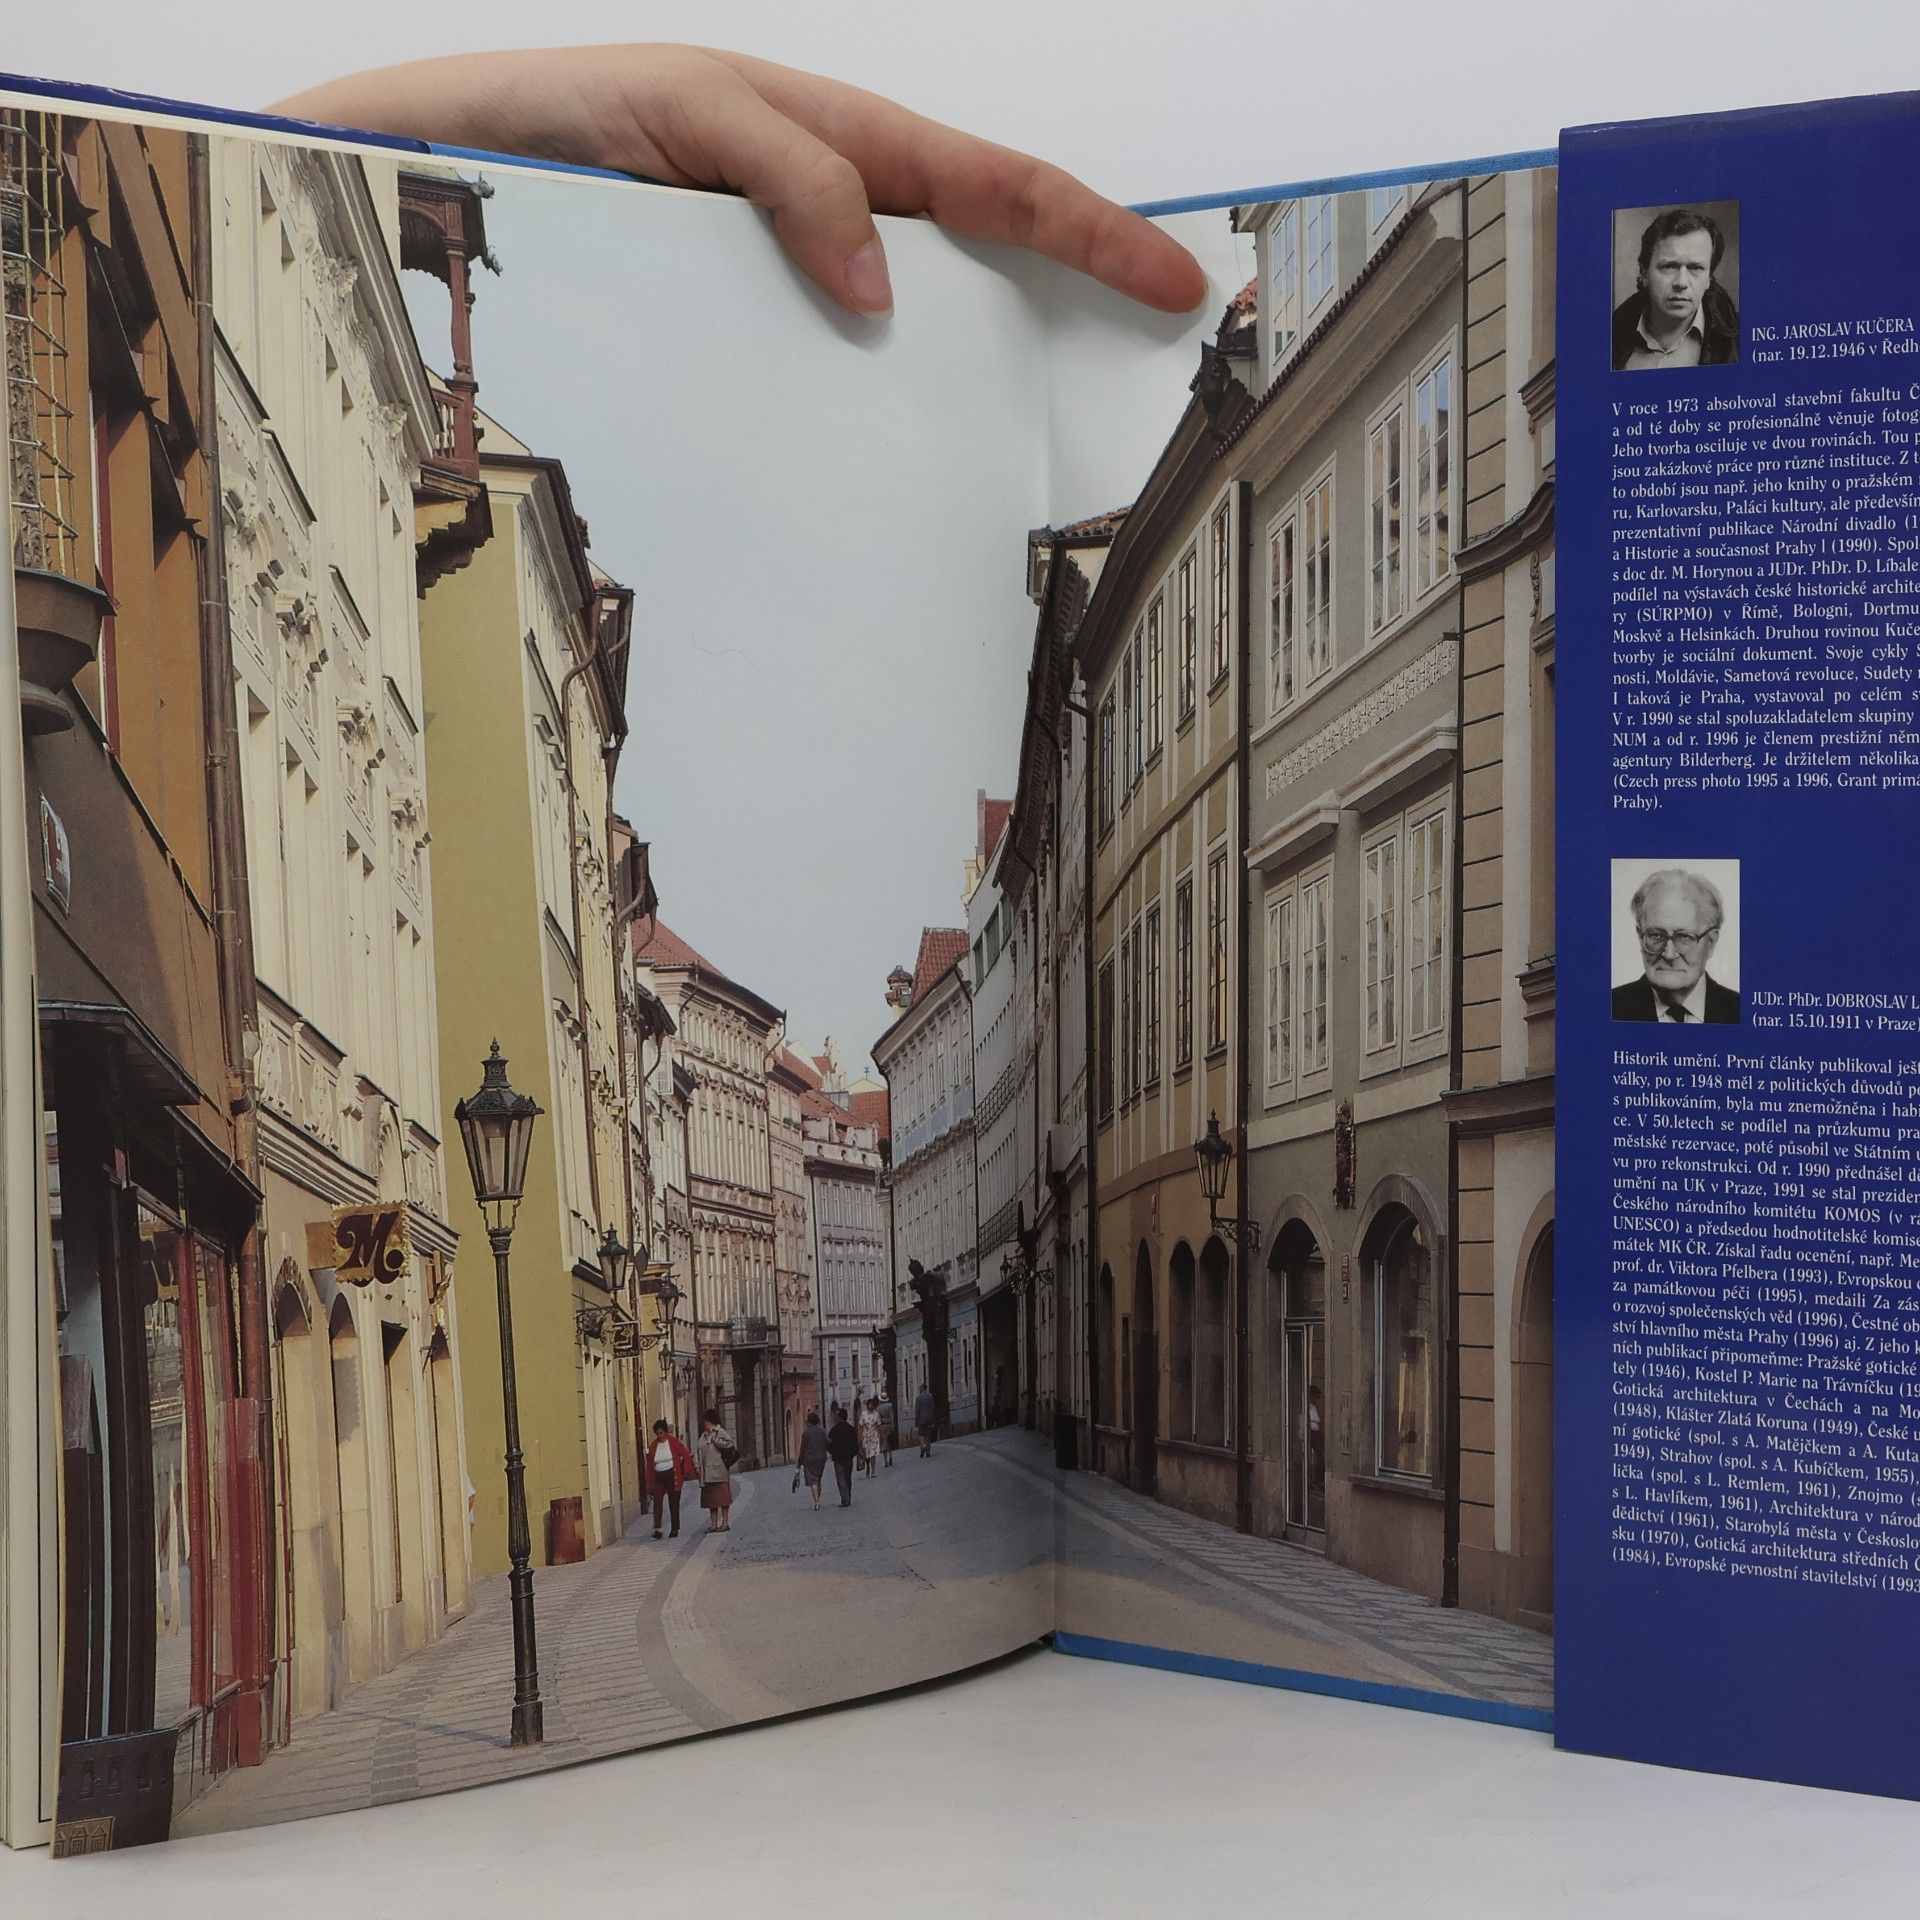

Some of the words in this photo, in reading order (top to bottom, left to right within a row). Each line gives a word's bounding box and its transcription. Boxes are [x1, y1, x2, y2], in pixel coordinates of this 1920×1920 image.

[1752, 326, 1780, 342] ING.
[1783, 321, 1852, 340] JAROSLAV
[1856, 317, 1914, 335] KUČERA
[1752, 349, 1784, 363] (nar.
[1790, 341, 1865, 360] 19.12.1946
[1869, 345, 1877, 355] v
[1882, 337, 1920, 355] Ředh
[1612, 402, 1622, 416] V
[1630, 404, 1658, 415] roce
[1667, 398, 1699, 413] 1973
[1706, 393, 1776, 411] absolvoval
[1784, 389, 1843, 407] stavební
[1850, 386, 1901, 403] fakultu
[1612, 442, 1643, 458] Jeho
[1648, 440, 1690, 456] tvorba
[1695, 437, 1747, 454] osciluje
[1751, 440, 1767, 450] ve
[1772, 435, 1805, 450] dvou
[1811, 430, 1876, 448] rovinách.
[1881, 429, 1909, 444] Tou
[1613, 509, 1632, 520] ru,
[1636, 501, 1722, 518] Karlovarsku,
[1726, 499, 1767, 515] Paláci
[1771, 497, 1826, 514] kultury,
[1830, 495, 1850, 511] ale
[1612, 523, 1702, 543] prezentativní
[1709, 520, 1774, 539] publikace
[1782, 517, 1838, 534] Národní
[1845, 515, 1896, 531] divadlo
[1613, 586, 1657, 605] podílel
[1663, 590, 1679, 600] na
[1684, 583, 1749, 603] výstavách
[1755, 582, 1792, 598] české
[1797, 580, 1867, 597] historické
[1613, 612, 1626, 625] ry
[1637, 604, 1713, 623] (SÚRPMO)
[1723, 609, 1731, 619] v
[1742, 602, 1782, 620] Římě,
[1793, 602, 1852, 620] Bologni,
[1613, 628, 1662, 643] Moskvě
[1667, 632, 1674, 642] a
[1680, 625, 1759, 642] Helsinkách.
[1765, 624, 1819, 640] Druhou
[1824, 624, 1879, 638] rovinou
[1613, 670, 1650, 686] nosti,
[1655, 669, 1719, 685] Moldávie,
[1723, 667, 1791, 683] Sametová
[1795, 666, 1858, 682] revoluce,
[1864, 665, 1913, 682] Sudety
[1612, 712, 1623, 726] V
[1627, 716, 1636, 726] r.
[1642, 711, 1673, 726] 1990
[1678, 715, 1692, 725] se
[1697, 710, 1720, 725] stal
[1725, 708, 1853, 727] spoluzakladatelem
[1858, 708, 1914, 725] skupiny
[1613, 753, 1673, 770] agentury
[1680, 752, 1756, 769] Bilderberg.
[1763, 752, 1777, 766] Je
[1785, 751, 1851, 766] držitelem
[1859, 750, 1919, 765] několika
[1613, 794, 1662, 811] Prahy).
[1751, 991, 1784, 1006] JUDr.
[1788, 992, 1822, 1007] PhDr.
[1826, 993, 1908, 1009] DOBROSLAV
[1753, 1012, 1783, 1028] (nar.
[1789, 1013, 1860, 1029] 15.10.1911
[1865, 1019, 1874, 1029] v
[1614, 1050, 1668, 1066] Historik
[1674, 1053, 1721, 1068] umění.
[1727, 1054, 1765, 1069] První
[1769, 1055, 1814, 1074] články
[1820, 1057, 1892, 1074] publikoval
[1613, 1095, 1620, 1105] s
[1625, 1092, 1721, 1111] publikováním,
[1726, 1095, 1754, 1113] byla
[1759, 1101, 1782, 1112] mu
[1882, 1102, 1886, 1116] i
[1613, 1134, 1667, 1149] městské
[1671, 1139, 1739, 1154] rezervace,
[1744, 1140, 1774, 1156] poté
[1779, 1140, 1829, 1157] působil
[1833, 1146, 1849, 1158] ve
[1854, 1144, 1911, 1160] Státním
[1613, 1192, 1669, 1211] Českého
[1676, 1198, 1746, 1215] národního
[1753, 1201, 1816, 1219] komitétu
[1824, 1206, 1881, 1223] KOMOS
[1889, 1209, 1903, 1226] (v
[1613, 1215, 1679, 1234] UNESCO)
[1685, 1223, 1693, 1234] a
[1698, 1220, 1767, 1238] předsedou
[1613, 1257, 1643, 1273] prof.
[1647, 1258, 1664, 1274] dr.
[1668, 1260, 1718, 1277] Viktora
[1783, 1267, 1833, 1286] (1993),
[1837, 1270, 1912, 1290] Evropskou
[1613, 1302, 1621, 1312] o
[1624, 1301, 1665, 1318] rozvoj
[1669, 1302, 1766, 1324] společenských
[1769, 1309, 1793, 1324] věd
[1797, 1311, 1848, 1329] (1996),
[1851, 1312, 1899, 1332] Čestné
[1903, 1318, 1920, 1333] ob
[1613, 1340, 1642, 1355] ních
[1646, 1342, 1708, 1360] publikací
[1711, 1347, 1803, 1367] připomeňme:
[1807, 1353, 1862, 1372] Pražské
[1865, 1360, 1917, 1376] gotické
[1613, 1381, 1664, 1398] Gotická
[1673, 1386, 1757, 1406] architektura
[1767, 1397, 1775, 1407] v
[1784, 1392, 1843, 1413] Čechách
[1853, 1404, 1861, 1415] a
[1871, 1405, 1889, 1417] na
[1614, 1443, 1655, 1462] 1949),
[1660, 1447, 1713, 1464] Strahov
[1719, 1452, 1755, 1470] (spol.
[1761, 1460, 1768, 1470] s
[1773, 1457, 1787, 1472] A.
[1794, 1459, 1869, 1481] Kubíčkem,
[1876, 1467, 1919, 1486] 1955),
[1612, 1504, 1664, 1523] dědictví
[1671, 1511, 1719, 1531] (1961),
[1725, 1516, 1790, 1538] Starobylá
[1796, 1524, 1837, 1541] města
[1843, 1532, 1851, 1542] v
[1857, 1527, 1920, 1549] Českoslo
[1613, 1546, 1660, 1566] (1984),
[1665, 1552, 1727, 1572] Evropské
[1731, 1563, 1798, 1580] pevnostní
[1802, 1568, 1877, 1588] stavitelství
